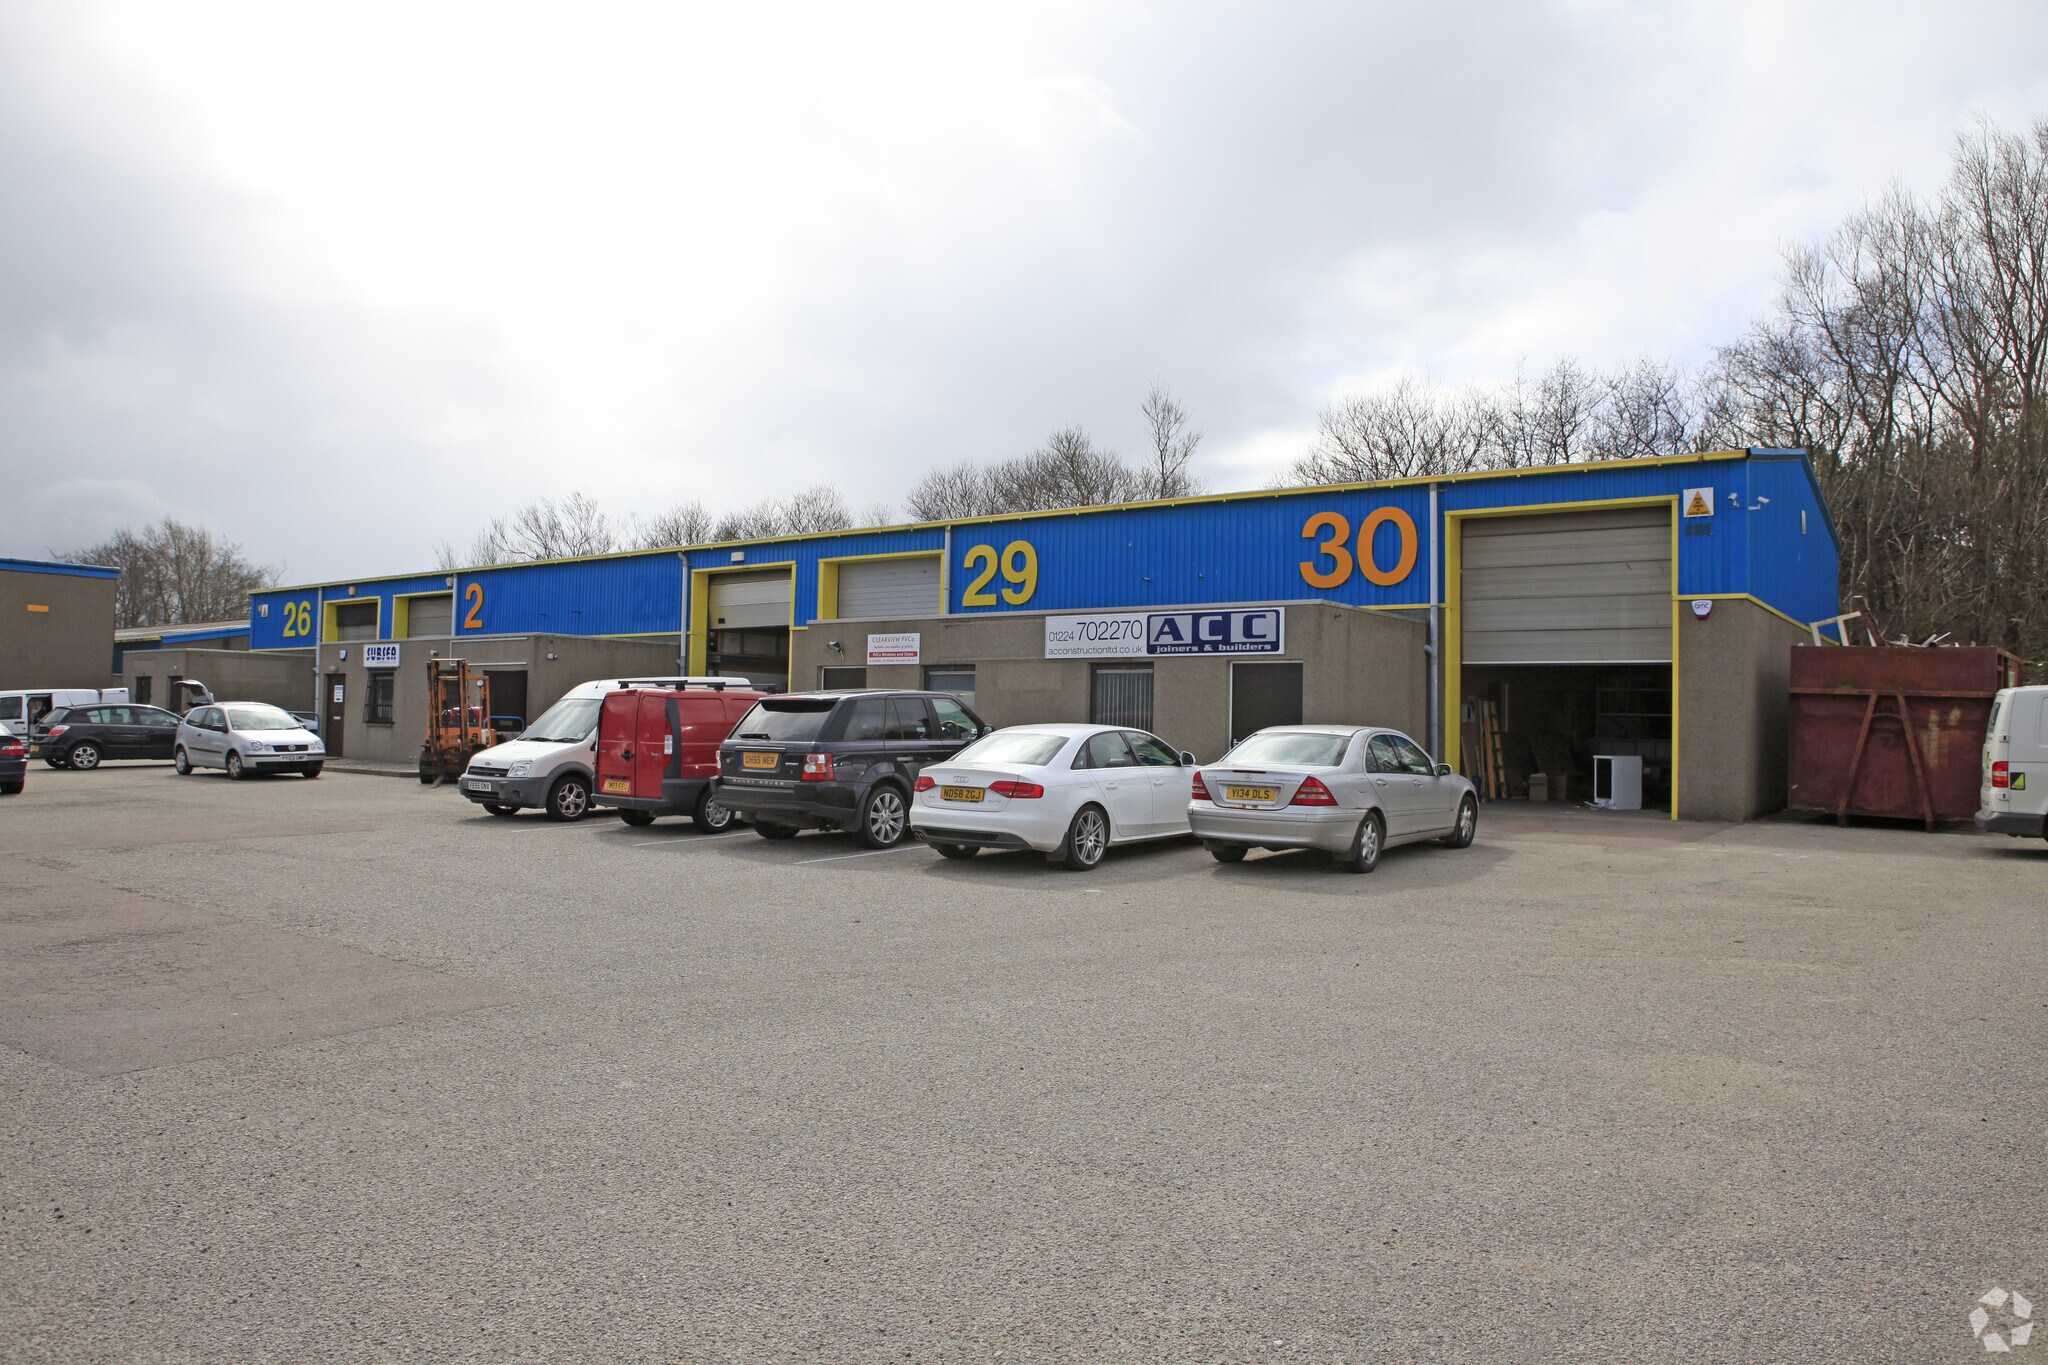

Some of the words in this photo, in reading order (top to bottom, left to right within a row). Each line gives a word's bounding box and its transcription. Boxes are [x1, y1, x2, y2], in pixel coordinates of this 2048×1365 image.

[1299, 506, 1419, 589] 30
[962, 540, 1038, 607] 29
[464, 583, 484, 629] 2
[283, 600, 312, 637] 26
[1153, 613, 1268, 642] ACC
[1048, 631, 1075, 642] 01224
[1076, 620, 1143, 641] 702270
[366, 646, 397, 661] SUBSEA
[1048, 645, 1143, 656] acconstructionltd.co.uk
[1155, 645, 1199, 654] joiners
[1203, 643, 1213, 652] &
[1218, 643, 1272, 652] builders
[745, 755, 760, 764] CH55
[762, 756, 775, 765] NER
[943, 788, 964, 798] ND58
[965, 790, 981, 800] ZGJ
[1231, 788, 1250, 798] Y134
[1252, 789, 1270, 799] DLS
